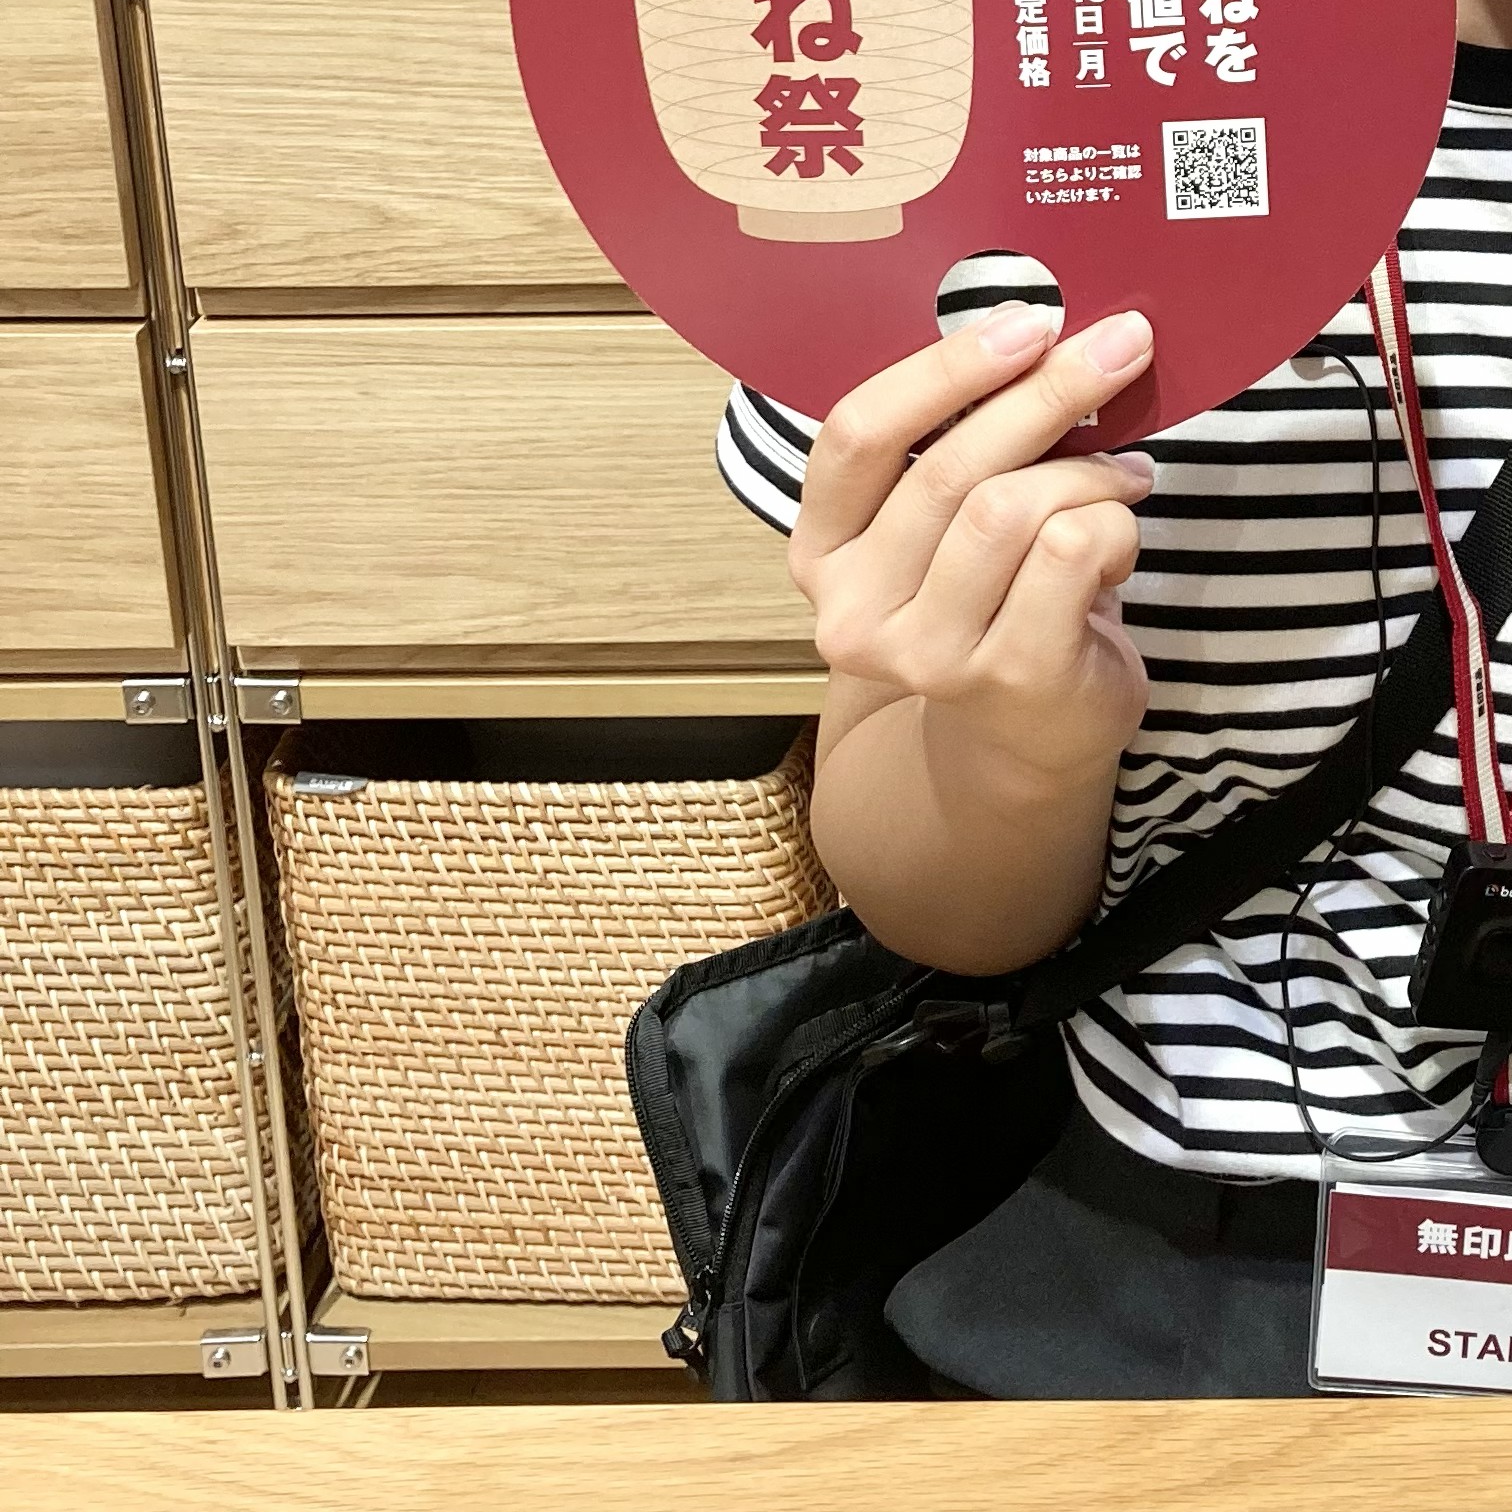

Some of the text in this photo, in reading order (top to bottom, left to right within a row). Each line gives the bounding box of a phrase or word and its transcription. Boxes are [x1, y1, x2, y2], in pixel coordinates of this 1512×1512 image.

[1023, 144, 1141, 163] 対象商品の一覧は
[1025, 164, 1143, 183] こちらよりご確認
[1025, 186, 1121, 204] いただけます。
